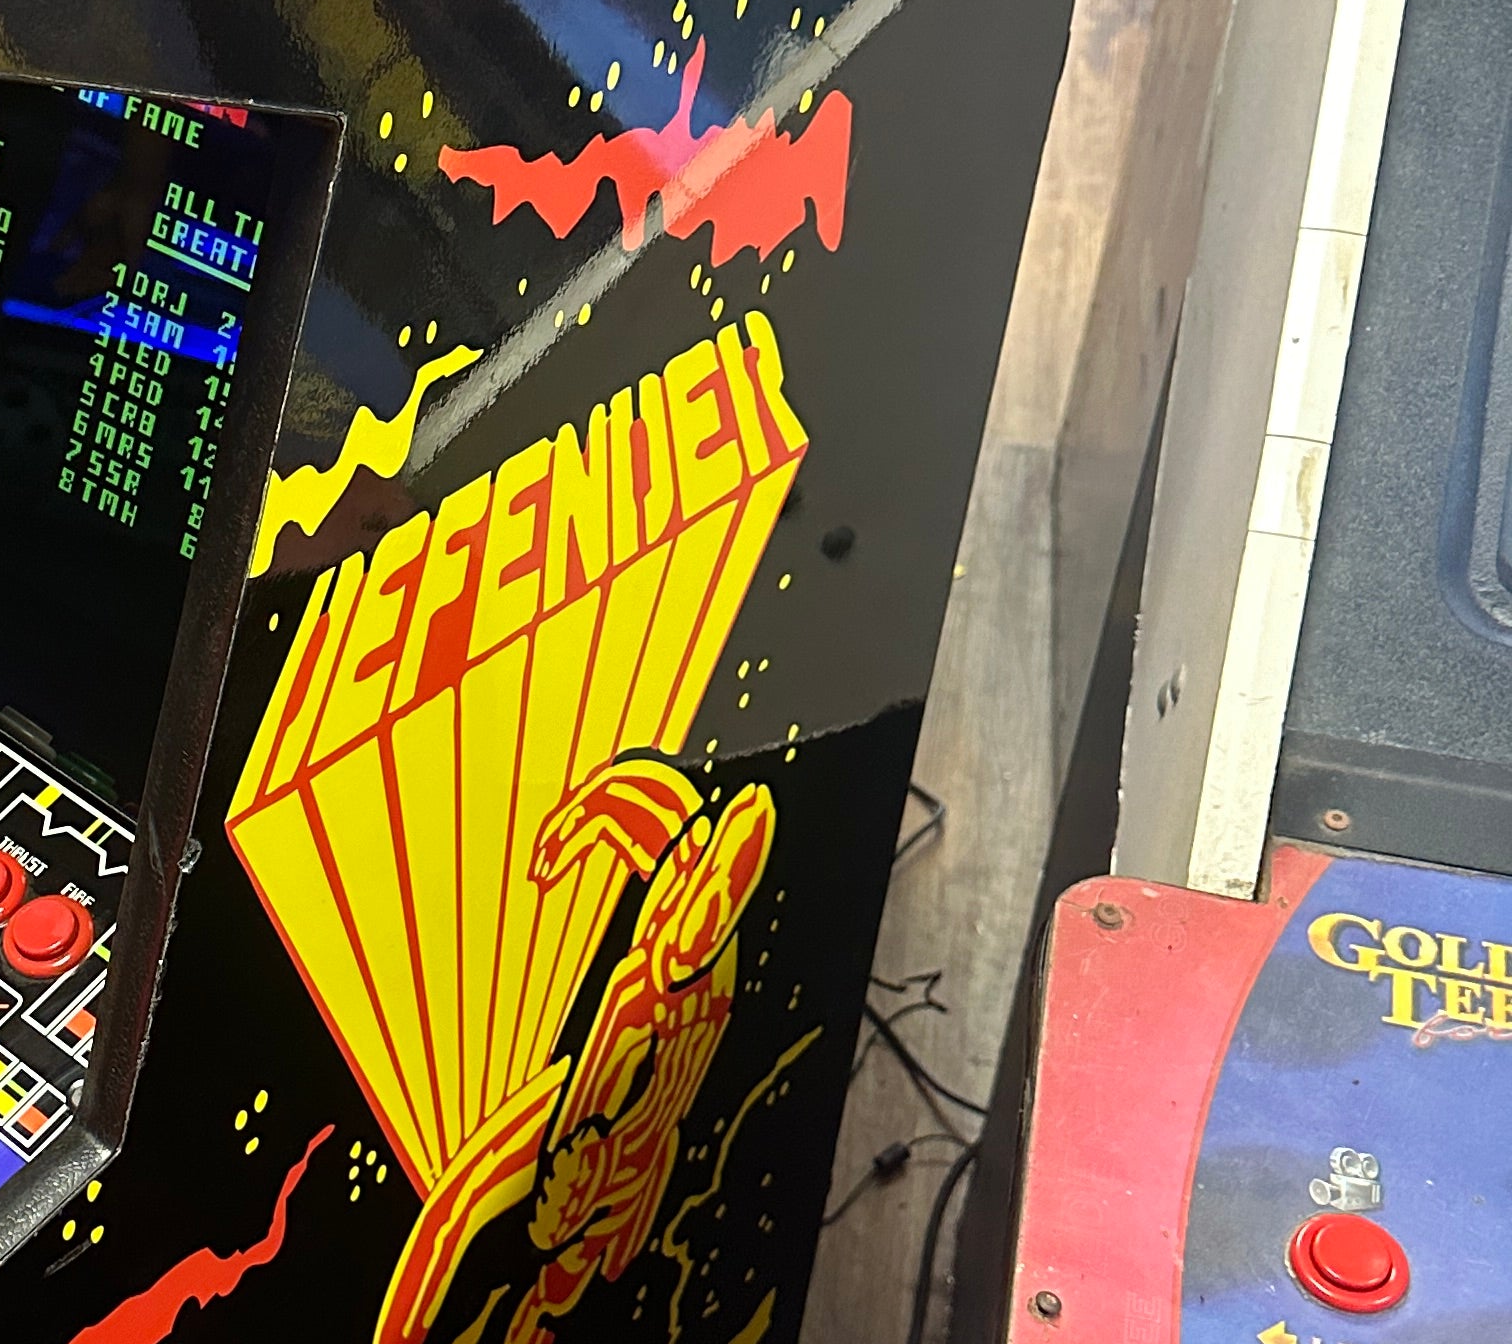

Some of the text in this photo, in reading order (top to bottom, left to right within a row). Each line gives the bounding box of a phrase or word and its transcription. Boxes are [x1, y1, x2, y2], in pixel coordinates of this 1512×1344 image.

[123, 95, 204, 149] FAME
[164, 182, 217, 227] ALL
[152, 211, 257, 279] GREAT
[125, 302, 185, 349] SAM
[132, 271, 188, 317] DRJ
[217, 311, 242, 339] 2
[117, 332, 171, 376] LED
[87, 449, 141, 496] SSR
[187, 502, 205, 531] 8
[95, 420, 153, 469] MRS
[180, 466, 211, 500] 11
[82, 477, 138, 528] TMH
[179, 532, 198, 560] 6
[225, 310, 809, 825] DEFENDER
